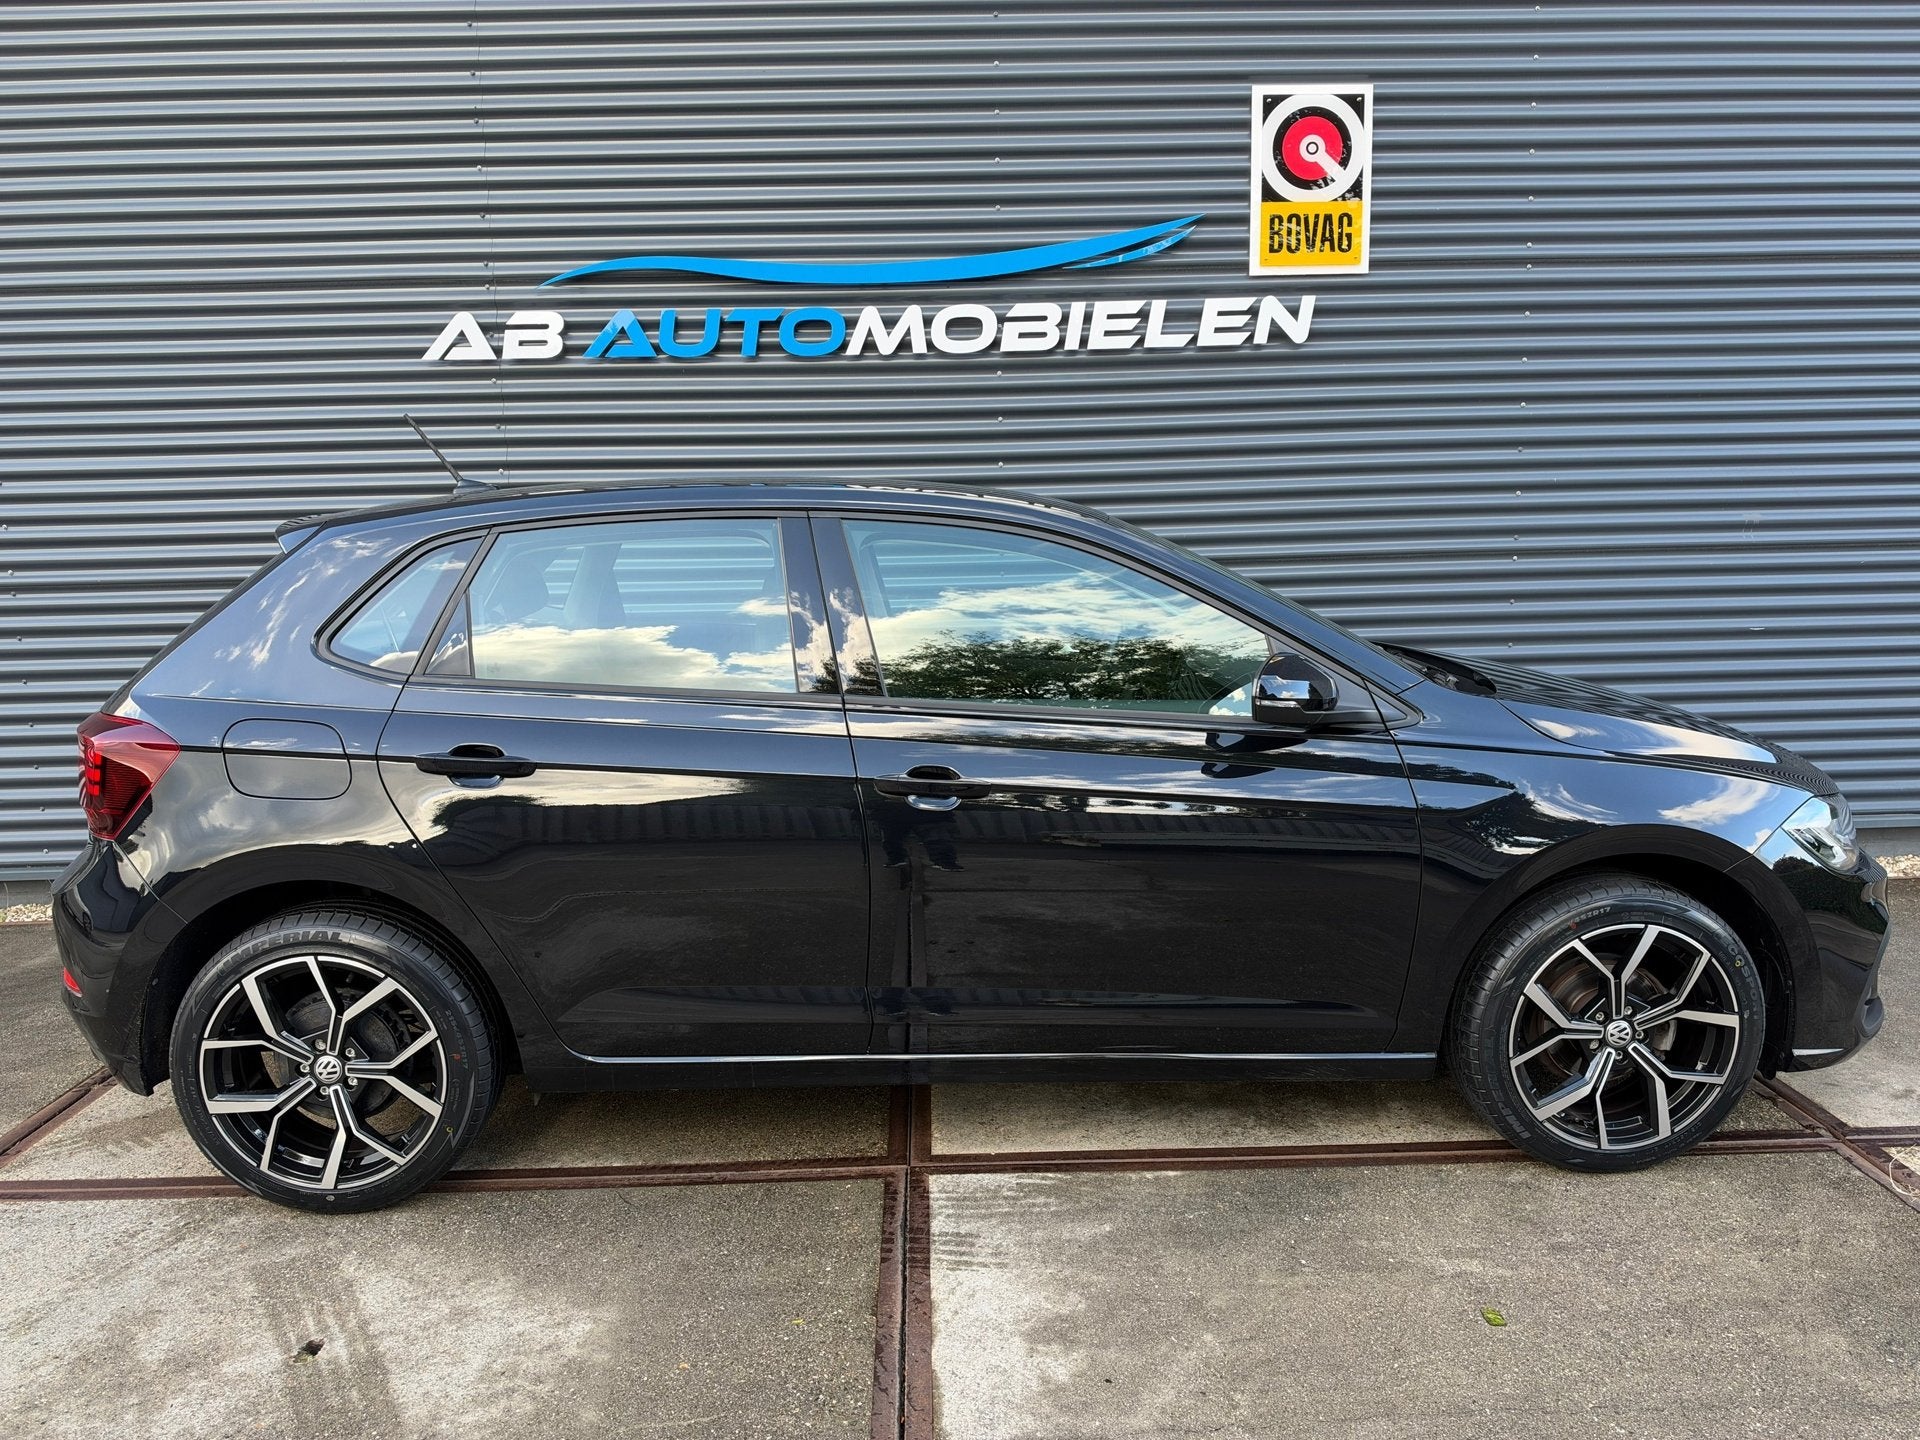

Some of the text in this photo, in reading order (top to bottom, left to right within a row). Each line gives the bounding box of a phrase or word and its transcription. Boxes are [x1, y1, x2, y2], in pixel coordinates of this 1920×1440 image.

[1269, 212, 1352, 253] BOVAG
[421, 295, 1316, 361] AB AUTOMOBIELEN
[221, 930, 344, 976] IMPERIAL
